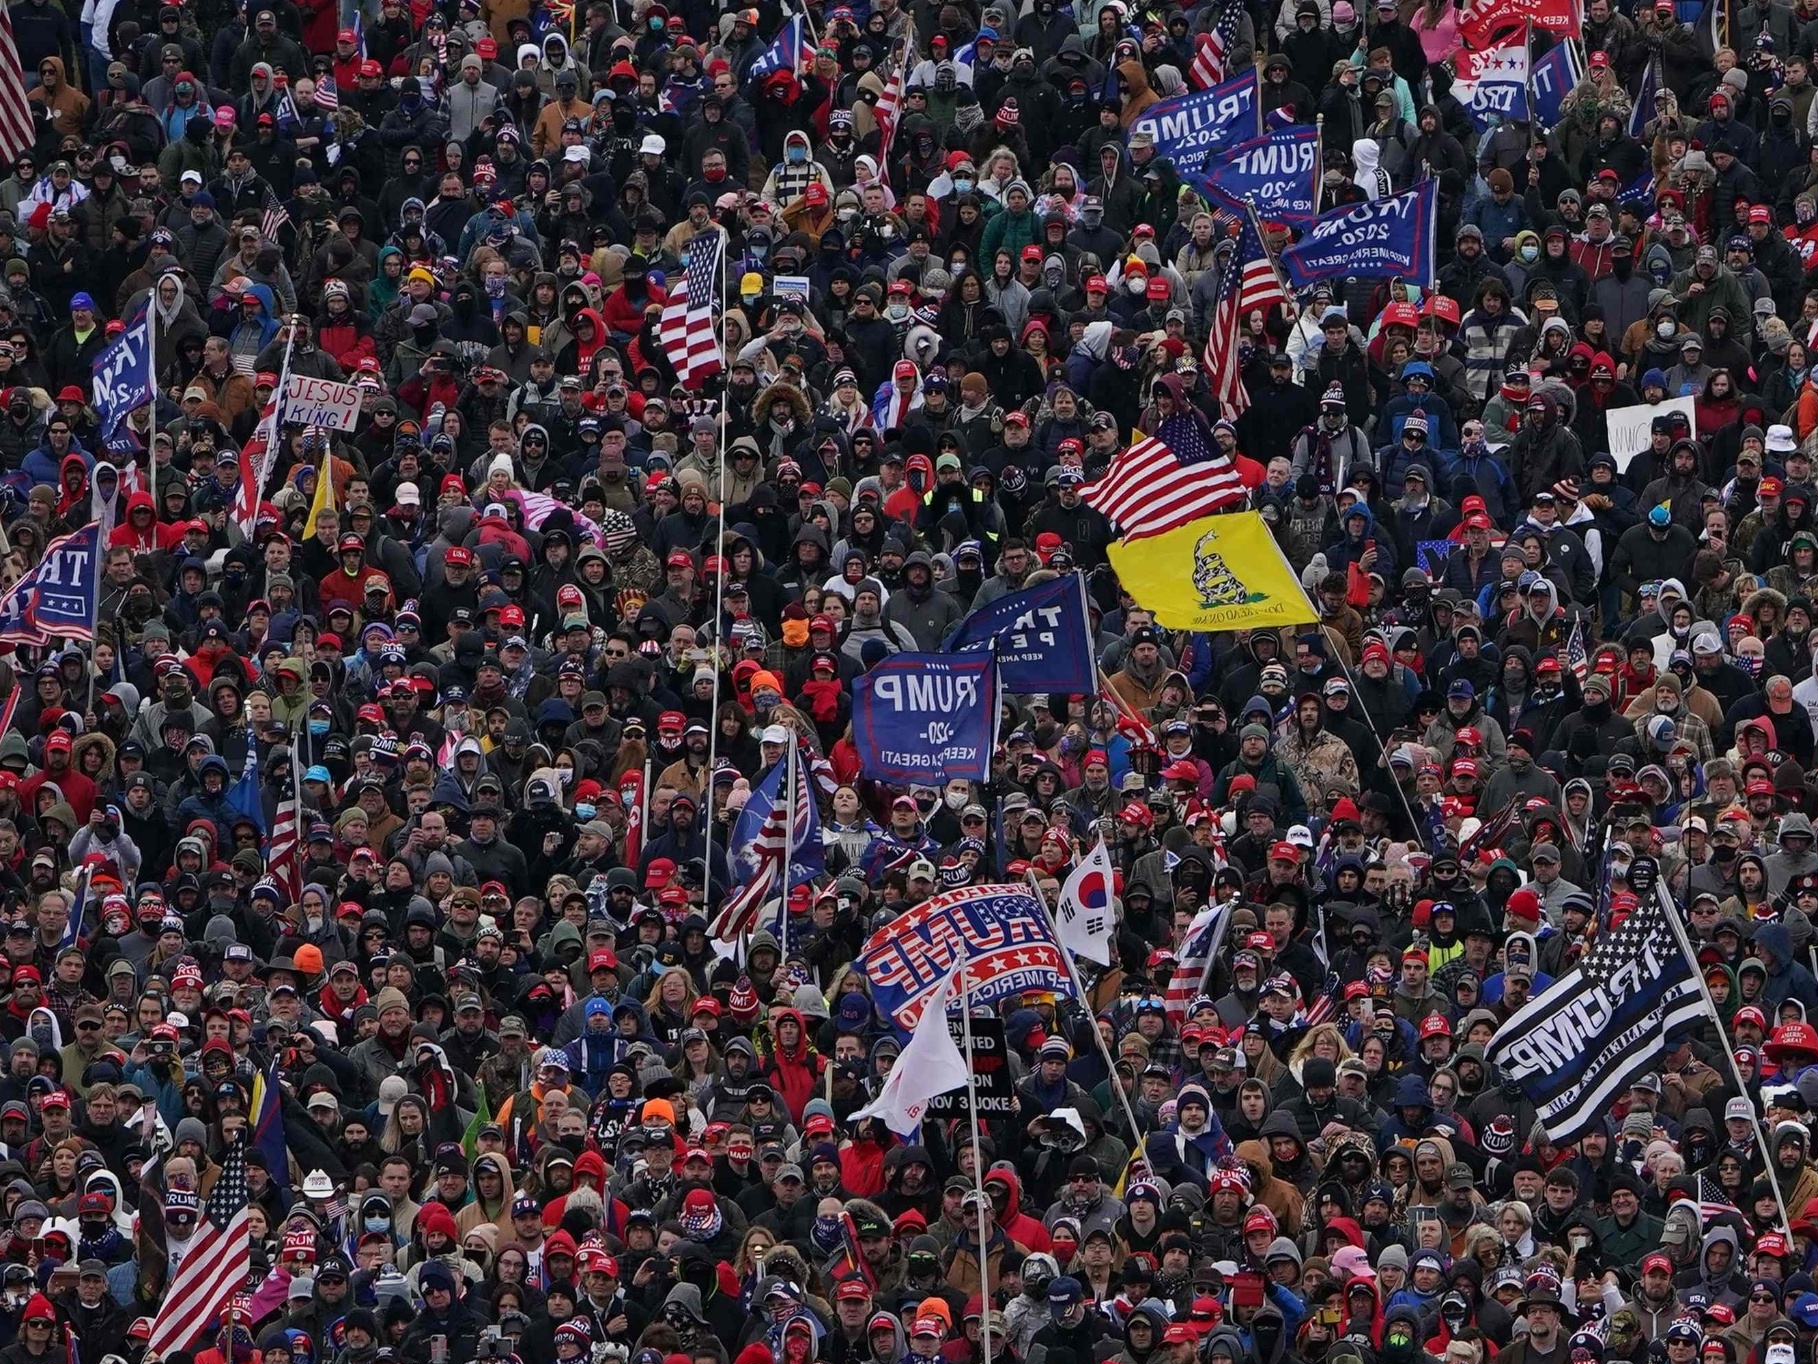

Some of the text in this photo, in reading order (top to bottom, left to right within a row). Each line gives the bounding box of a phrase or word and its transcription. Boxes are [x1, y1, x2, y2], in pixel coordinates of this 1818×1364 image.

[289, 378, 359, 406] JESUS
[314, 402, 325, 410] IS
[290, 405, 352, 429] KING!
[453, 549, 467, 558] USA
[1780, 1031, 1807, 1039] AMERICA
[1783, 1037, 1803, 1045] GREAT
[927, 1096, 1010, 1111] NOV 3 JOKE
[728, 1150, 752, 1159] MAGA
[284, 1234, 315, 1246] TRUM
[1498, 1271, 1521, 1280] TRUMP
[1689, 1296, 1706, 1304] USA
